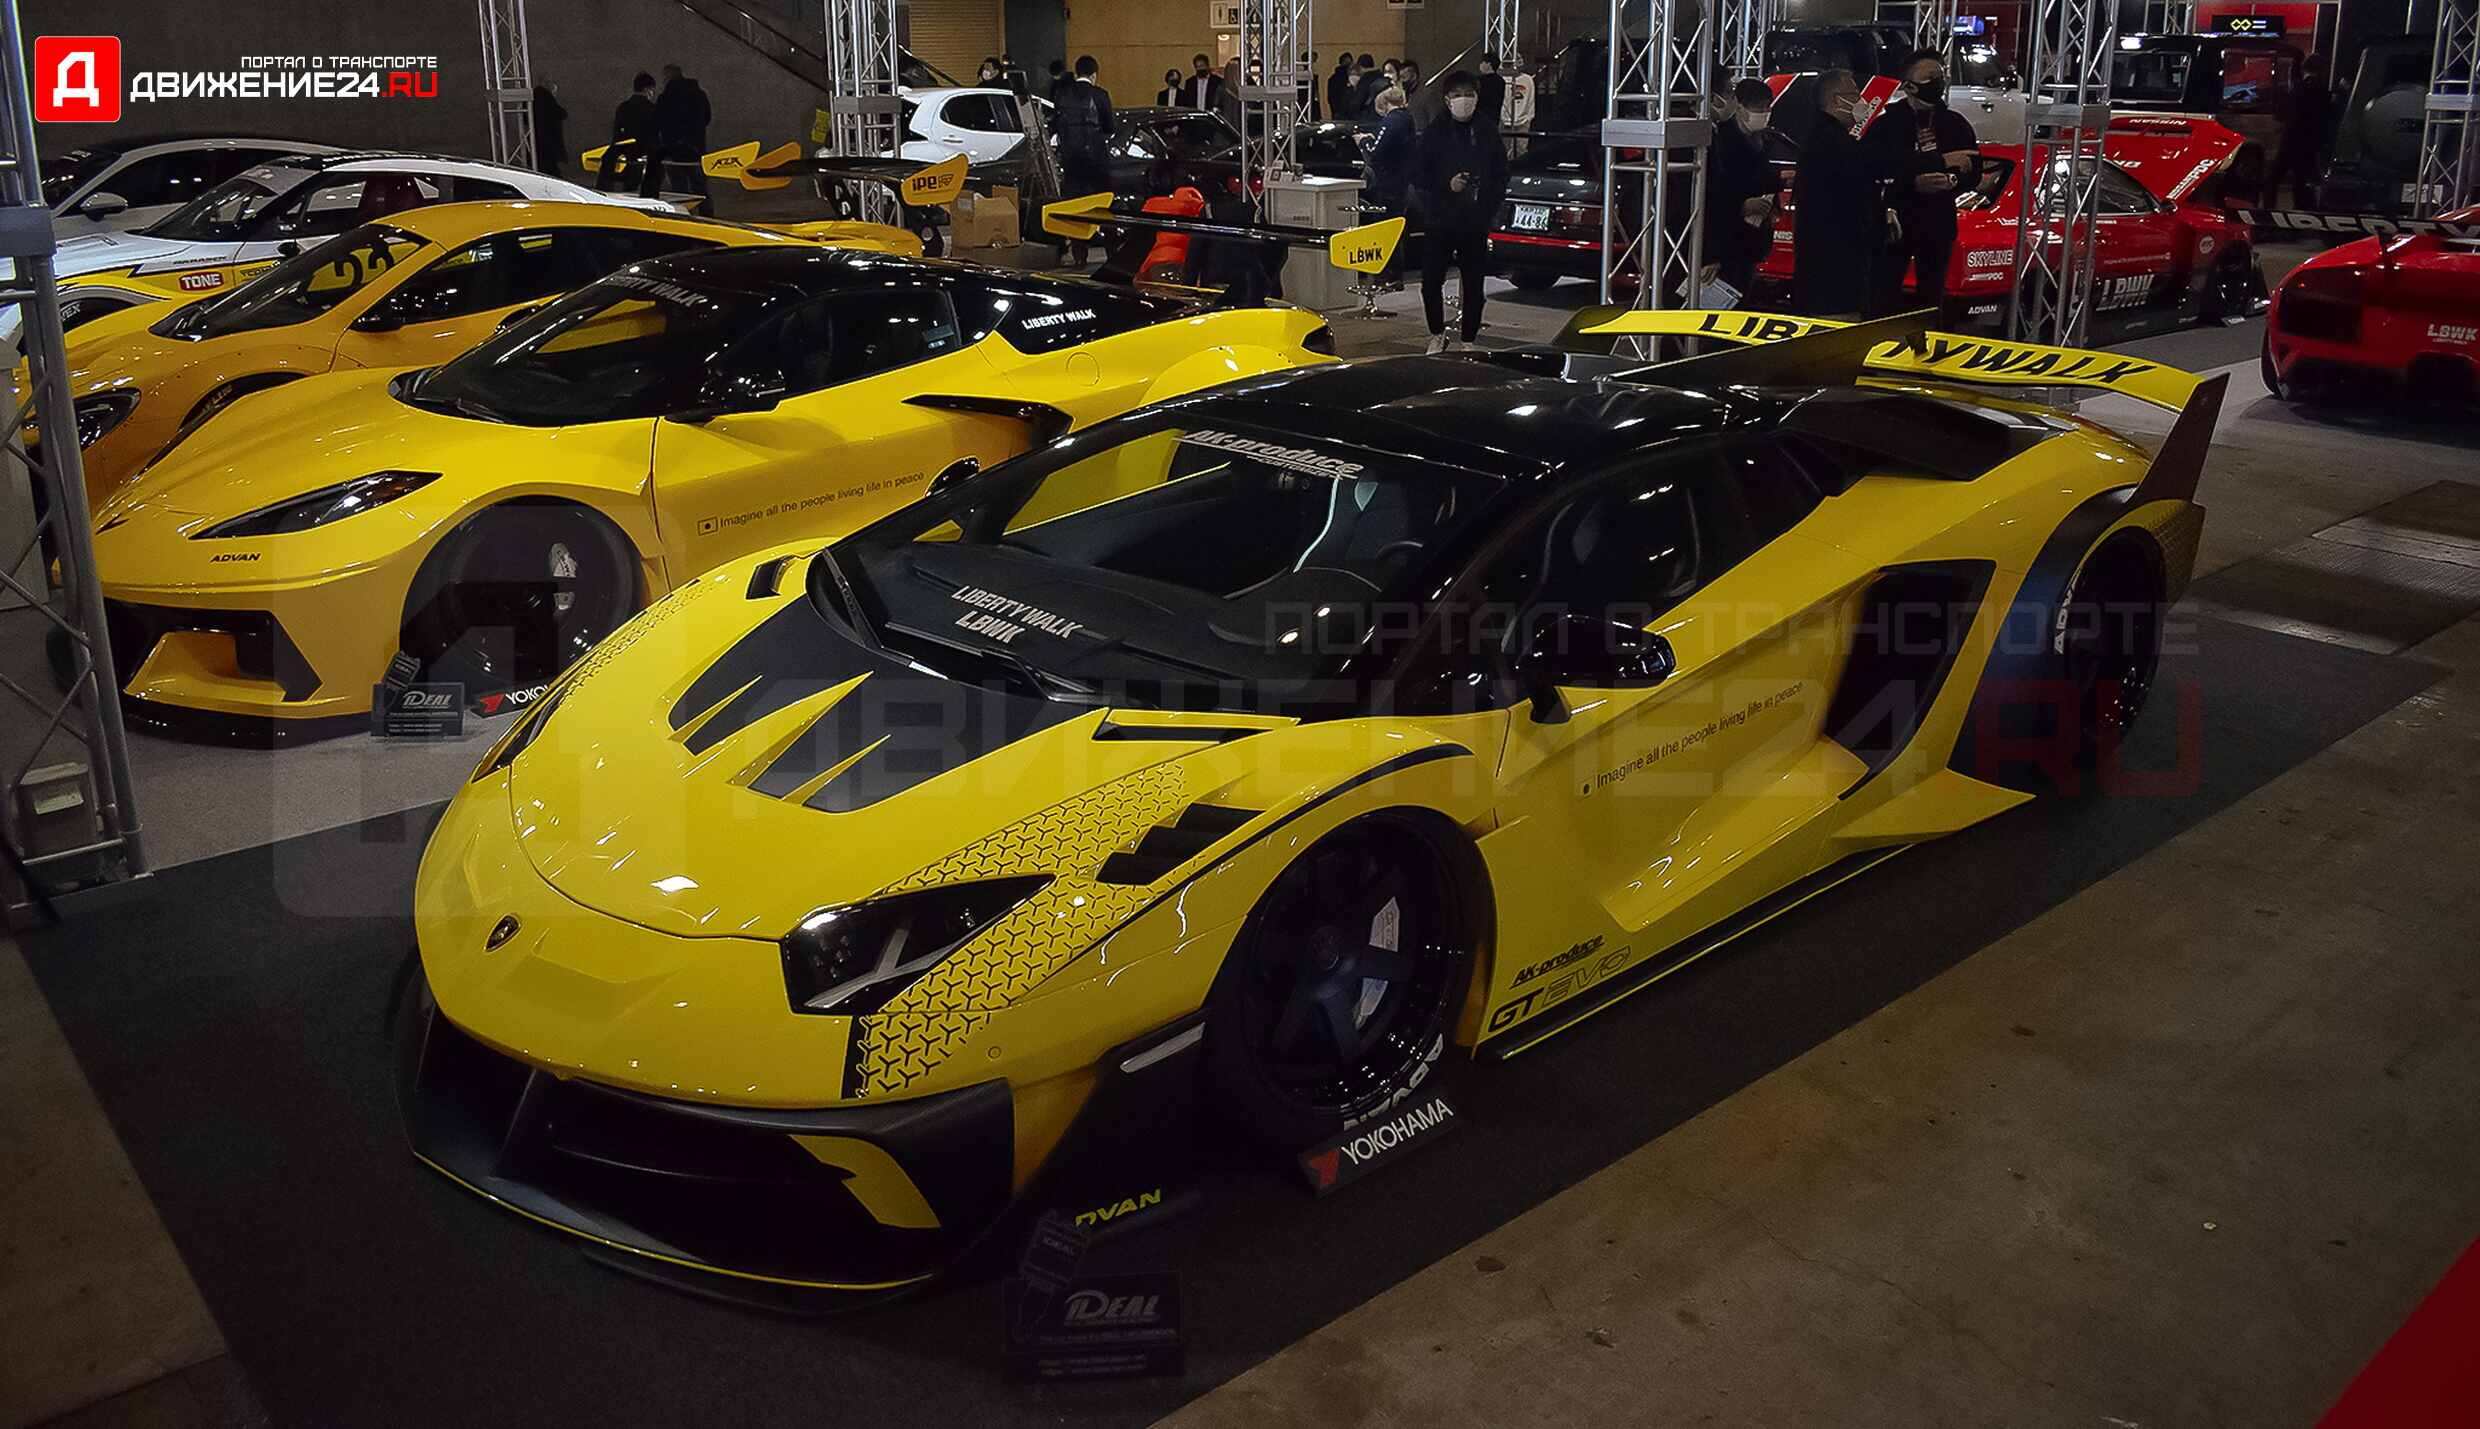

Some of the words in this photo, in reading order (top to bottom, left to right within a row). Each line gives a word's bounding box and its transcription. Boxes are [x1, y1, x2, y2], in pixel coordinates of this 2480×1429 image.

[1349, 247, 1383, 264] LBWK
[1968, 250, 2013, 267] SKYLINE
[181, 273, 222, 289] TONE
[1021, 312, 1066, 330] LIBERTY
[1065, 308, 1096, 322] WALK
[1968, 304, 1997, 314] ADVAN
[1698, 313, 1836, 341] LIB
[2427, 323, 2479, 341] LBWK
[720, 509, 763, 528] Imagine
[766, 504, 778, 517] all
[781, 501, 798, 513] the
[800, 493, 835, 510] people
[837, 485, 864, 501] living
[866, 481, 881, 493] life
[883, 478, 892, 489] in
[894, 471, 925, 488] peace
[209, 553, 261, 563] ADVAN
[951, 585, 1033, 618] LIBERTY
[1020, 607, 1083, 639] WALK
[954, 610, 1026, 643] LBWK
[1595, 756, 1644, 789] Imagine
[1645, 747, 1660, 765] all
[1661, 741, 1679, 757] the
[1681, 721, 1717, 752] people
[1718, 708, 1745, 731] living
[1746, 702, 1762, 719] life
[1764, 696, 1774, 709] in
[1774, 682, 1802, 708] peace
[1510, 934, 1605, 986] AK-produce
[1341, 1098, 1454, 1165] YOKOHAMA
[1075, 1188, 1161, 1227] DVAN
